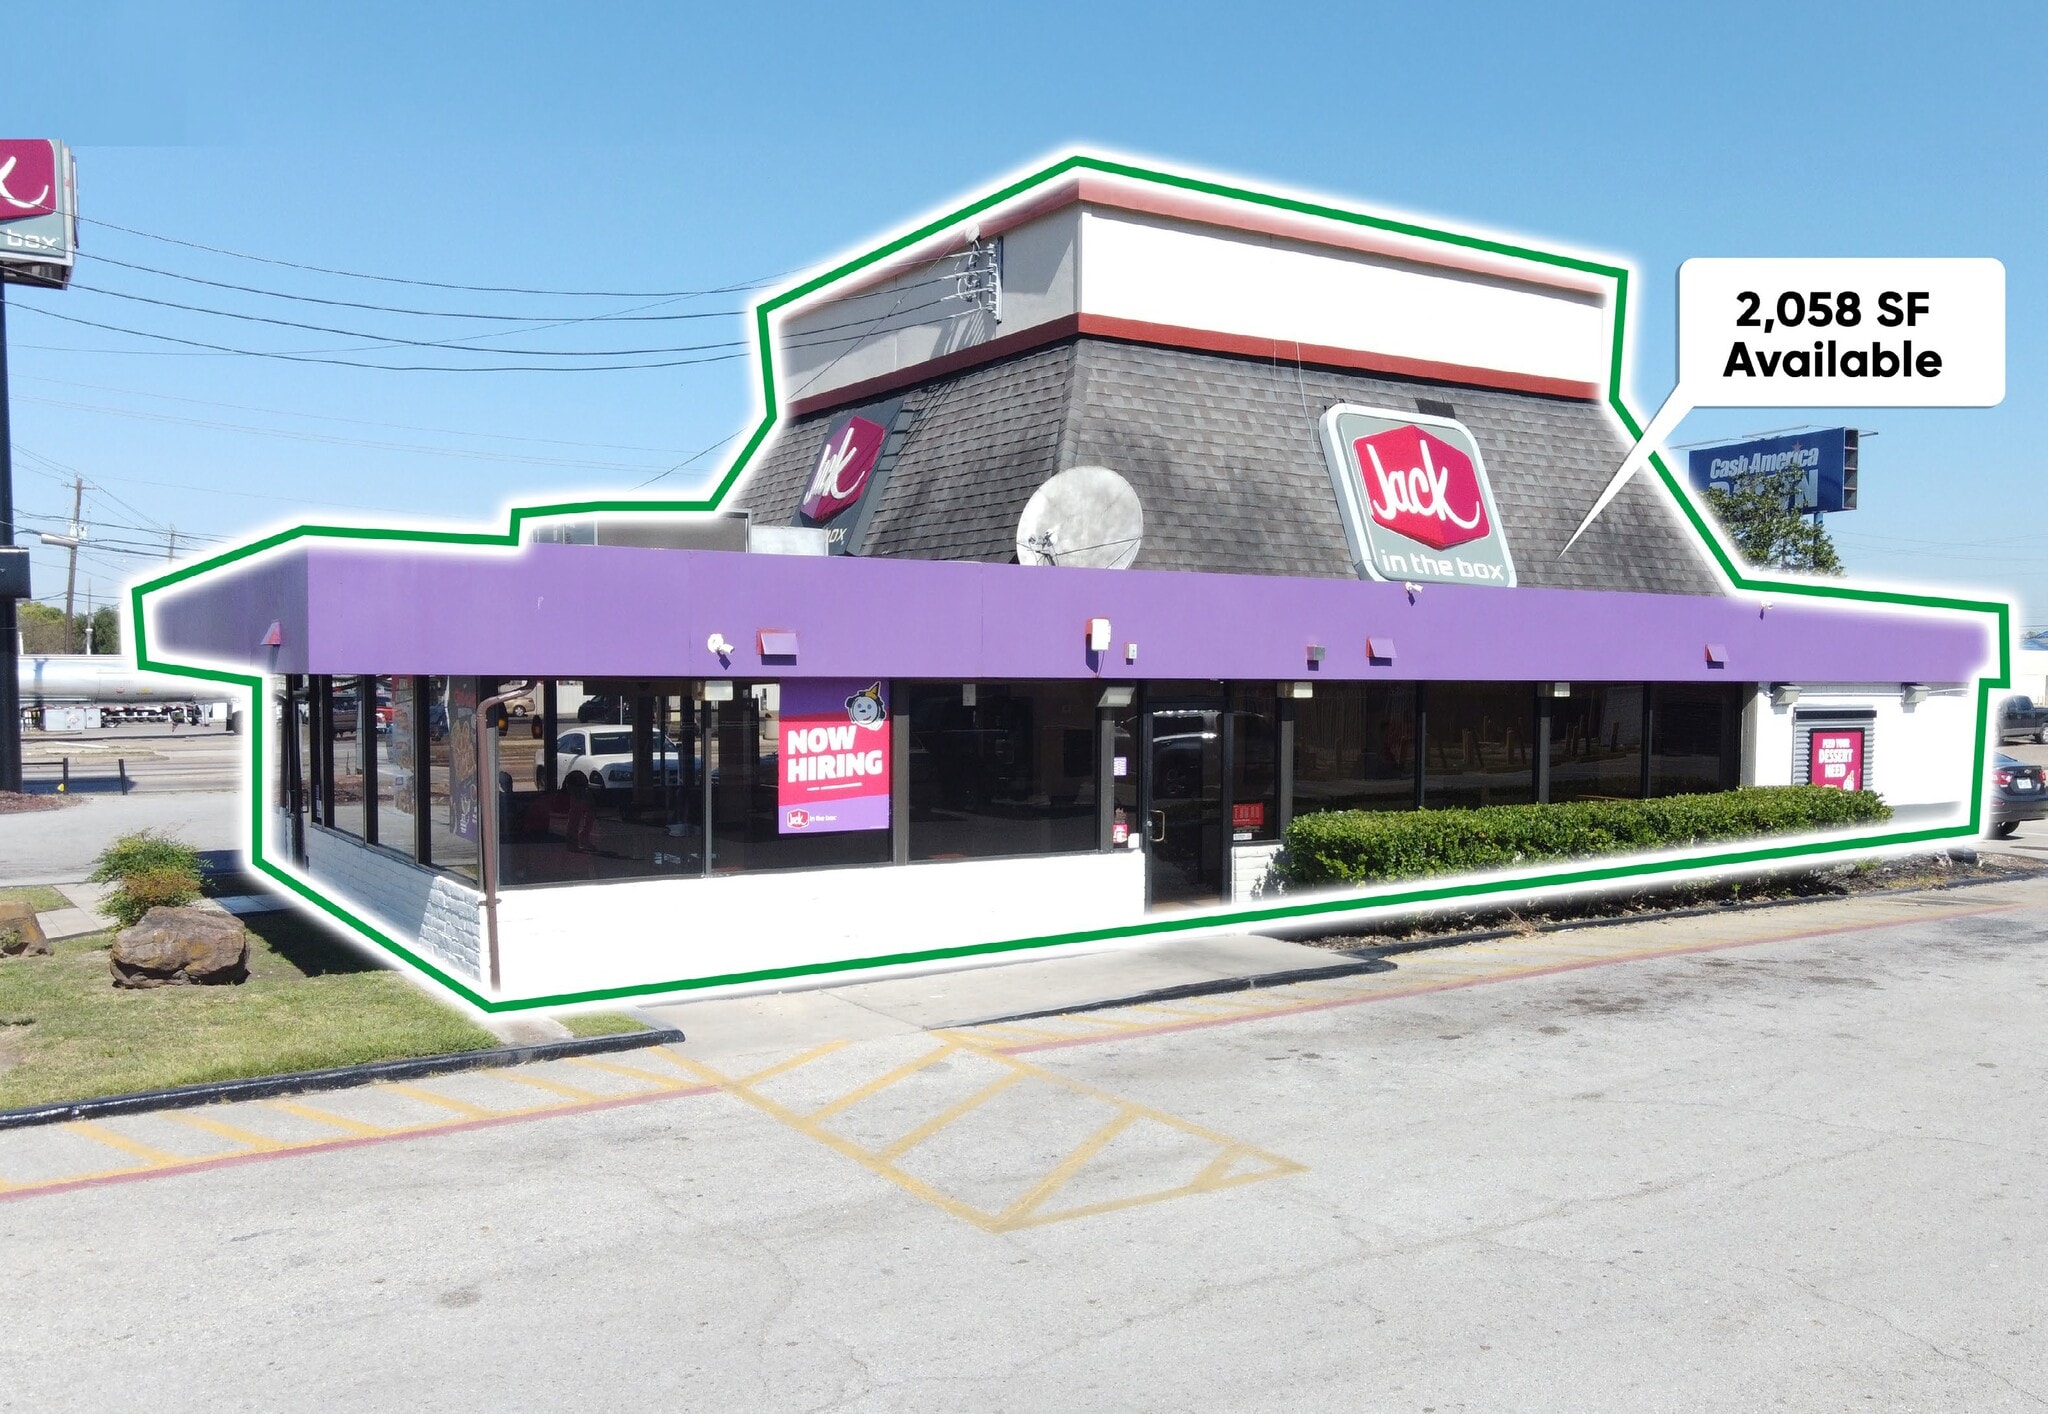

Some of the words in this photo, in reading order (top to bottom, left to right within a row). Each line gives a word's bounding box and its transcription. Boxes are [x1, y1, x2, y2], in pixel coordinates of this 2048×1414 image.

[7, 229, 58, 250] box
[1710, 455, 1748, 480] Cash
[1749, 447, 1820, 474] America
[1367, 439, 1480, 530] Jack
[1381, 549, 1408, 573] in
[1410, 553, 1453, 576] the
[1456, 557, 1503, 580] box
[788, 725, 857, 755] NOW
[787, 750, 883, 783] HIRING
